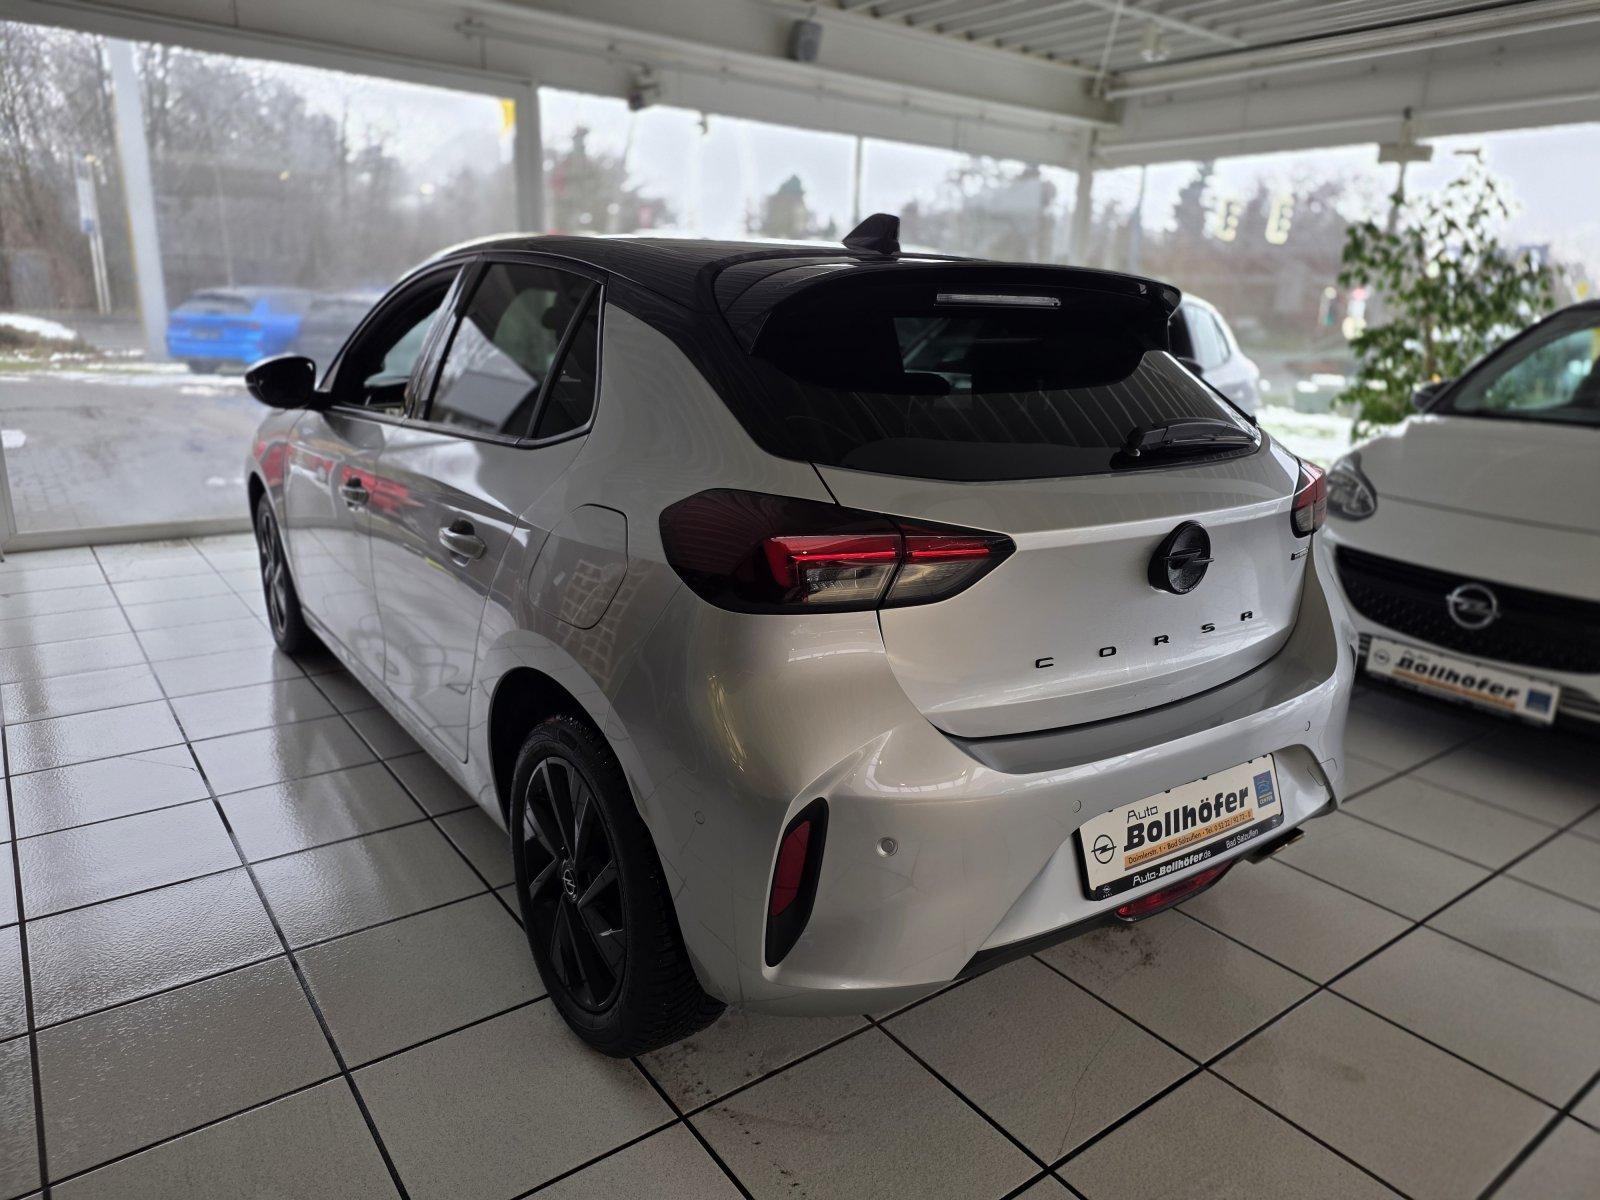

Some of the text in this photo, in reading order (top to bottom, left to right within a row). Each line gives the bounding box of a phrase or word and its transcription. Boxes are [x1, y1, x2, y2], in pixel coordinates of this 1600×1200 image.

[1035, 610, 1253, 669] CORSA
[1124, 786, 1249, 852] Bollhöfer
[1127, 806, 1158, 823] Auto
[1167, 839, 1178, 851] Bad
[1226, 838, 1237, 849] Bad
